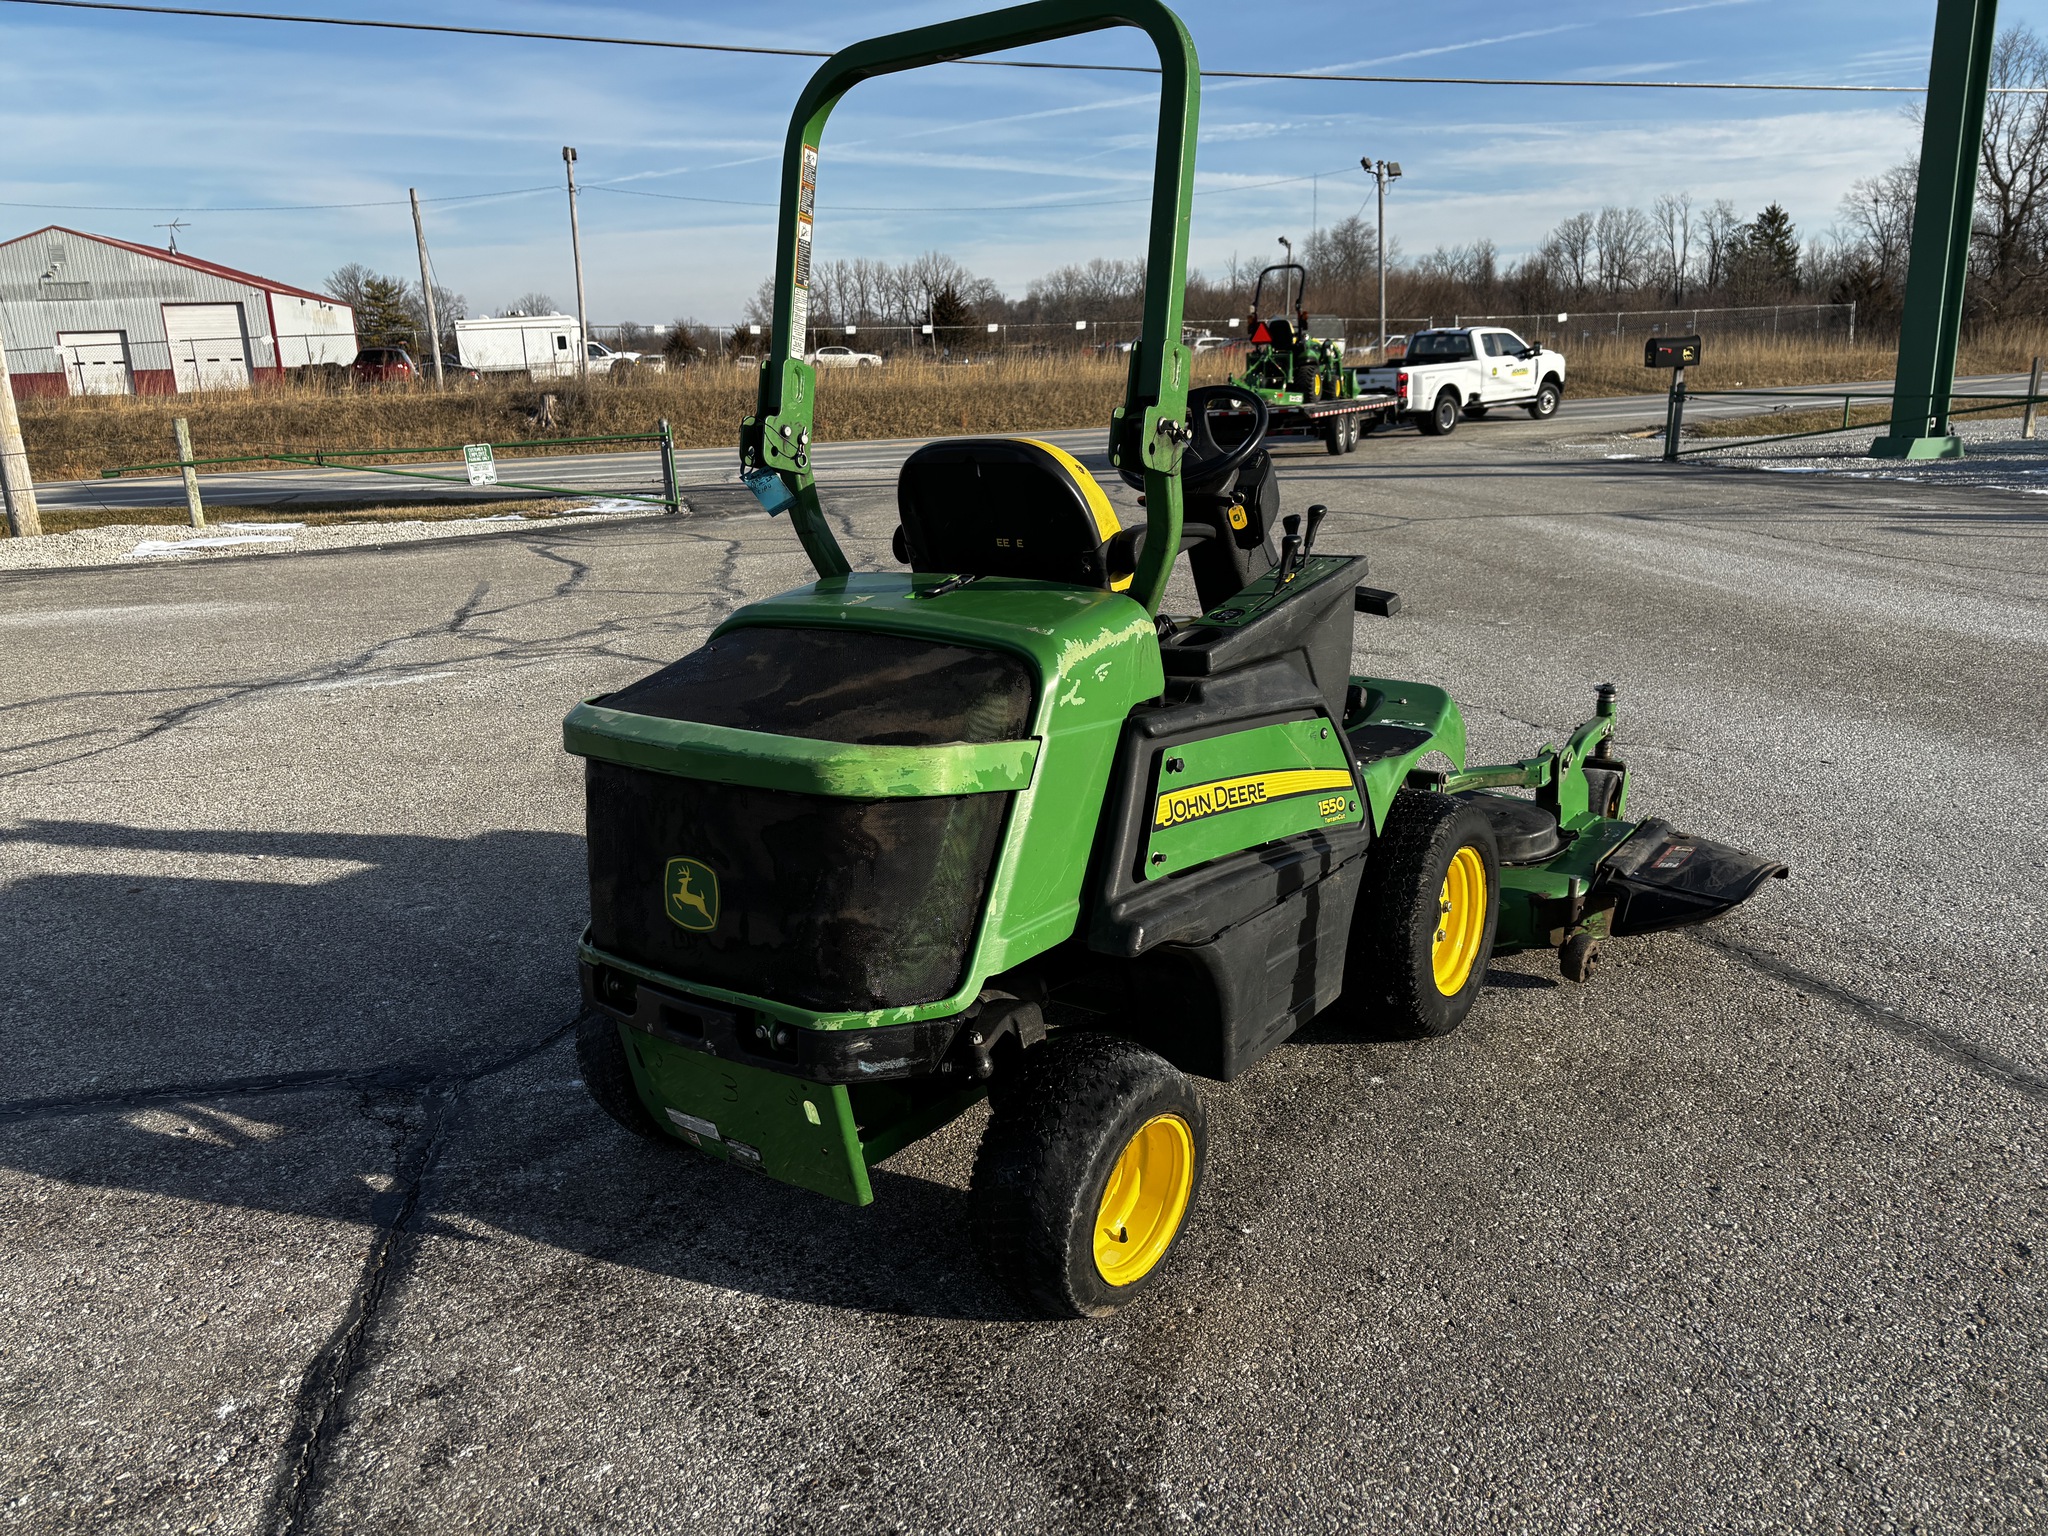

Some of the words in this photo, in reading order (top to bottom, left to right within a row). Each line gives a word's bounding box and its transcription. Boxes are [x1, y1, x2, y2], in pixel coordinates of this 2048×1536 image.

[1165, 793, 1212, 823] JOHN
[1214, 782, 1267, 808] DEERE
[1318, 796, 1346, 816] 1550
